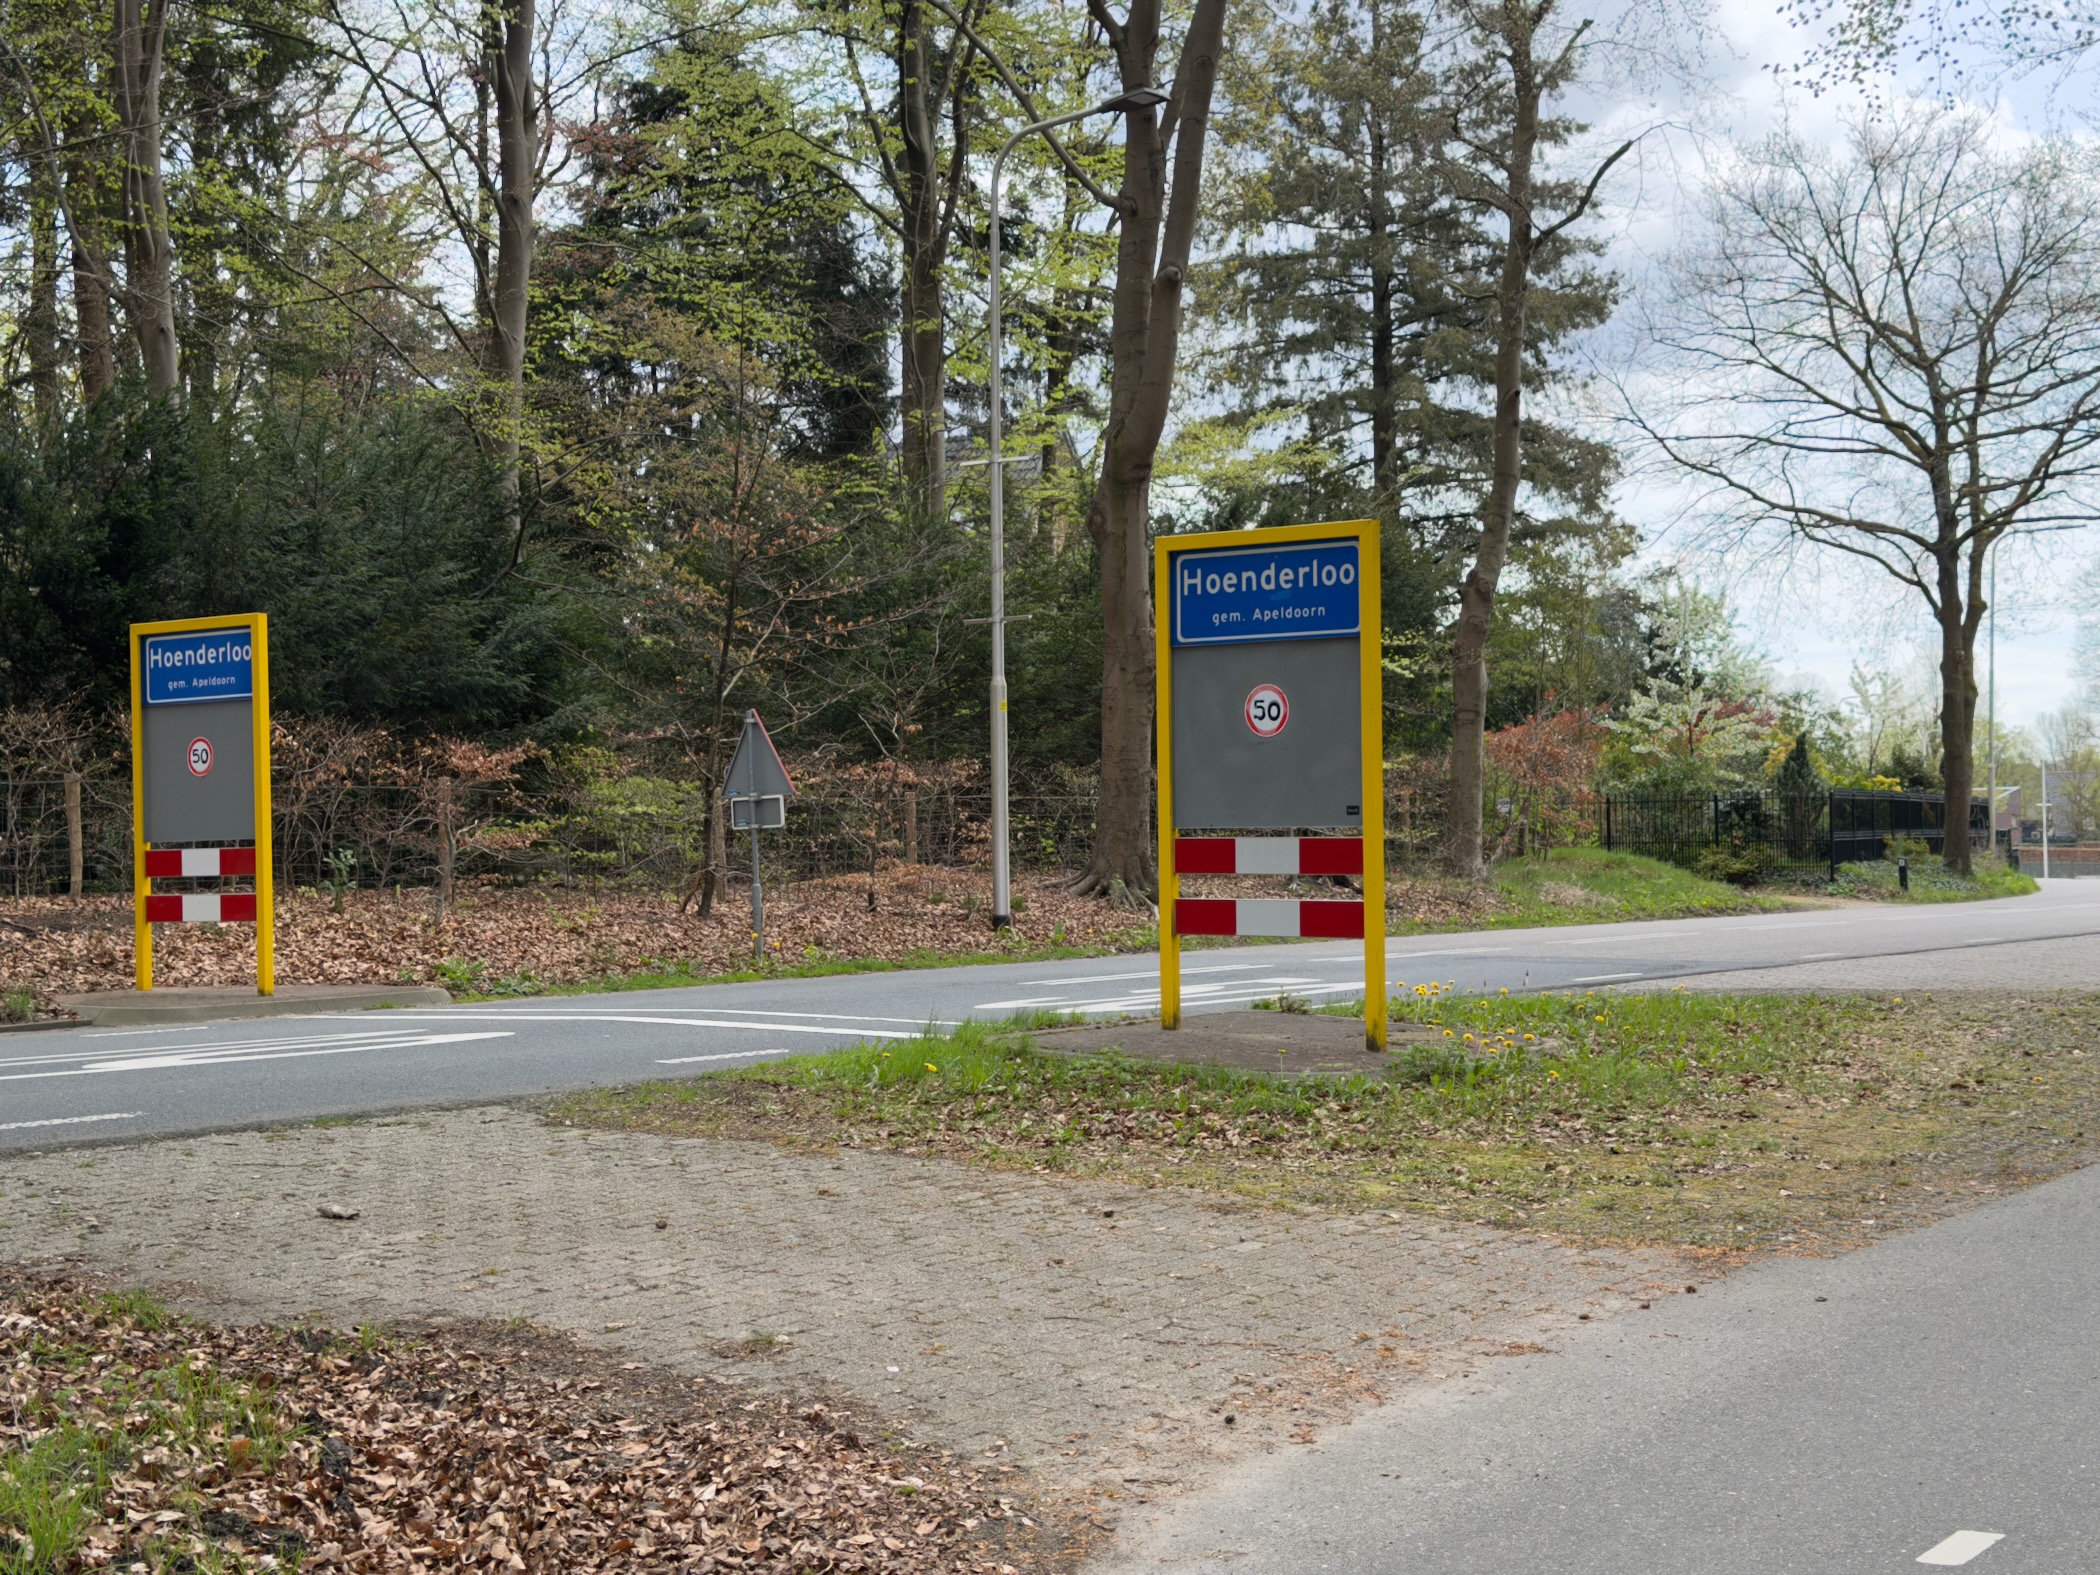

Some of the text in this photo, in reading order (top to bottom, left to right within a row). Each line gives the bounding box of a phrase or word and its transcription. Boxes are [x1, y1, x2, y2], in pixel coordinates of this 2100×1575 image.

[1183, 559, 1355, 596] Hoenderloo
[1212, 606, 1326, 626] gem. Apeldoorn
[150, 641, 252, 669] Hoenderloo
[168, 675, 236, 692] gem. Apeldoorn
[1253, 699, 1281, 721] 50
[192, 748, 209, 764] 50
